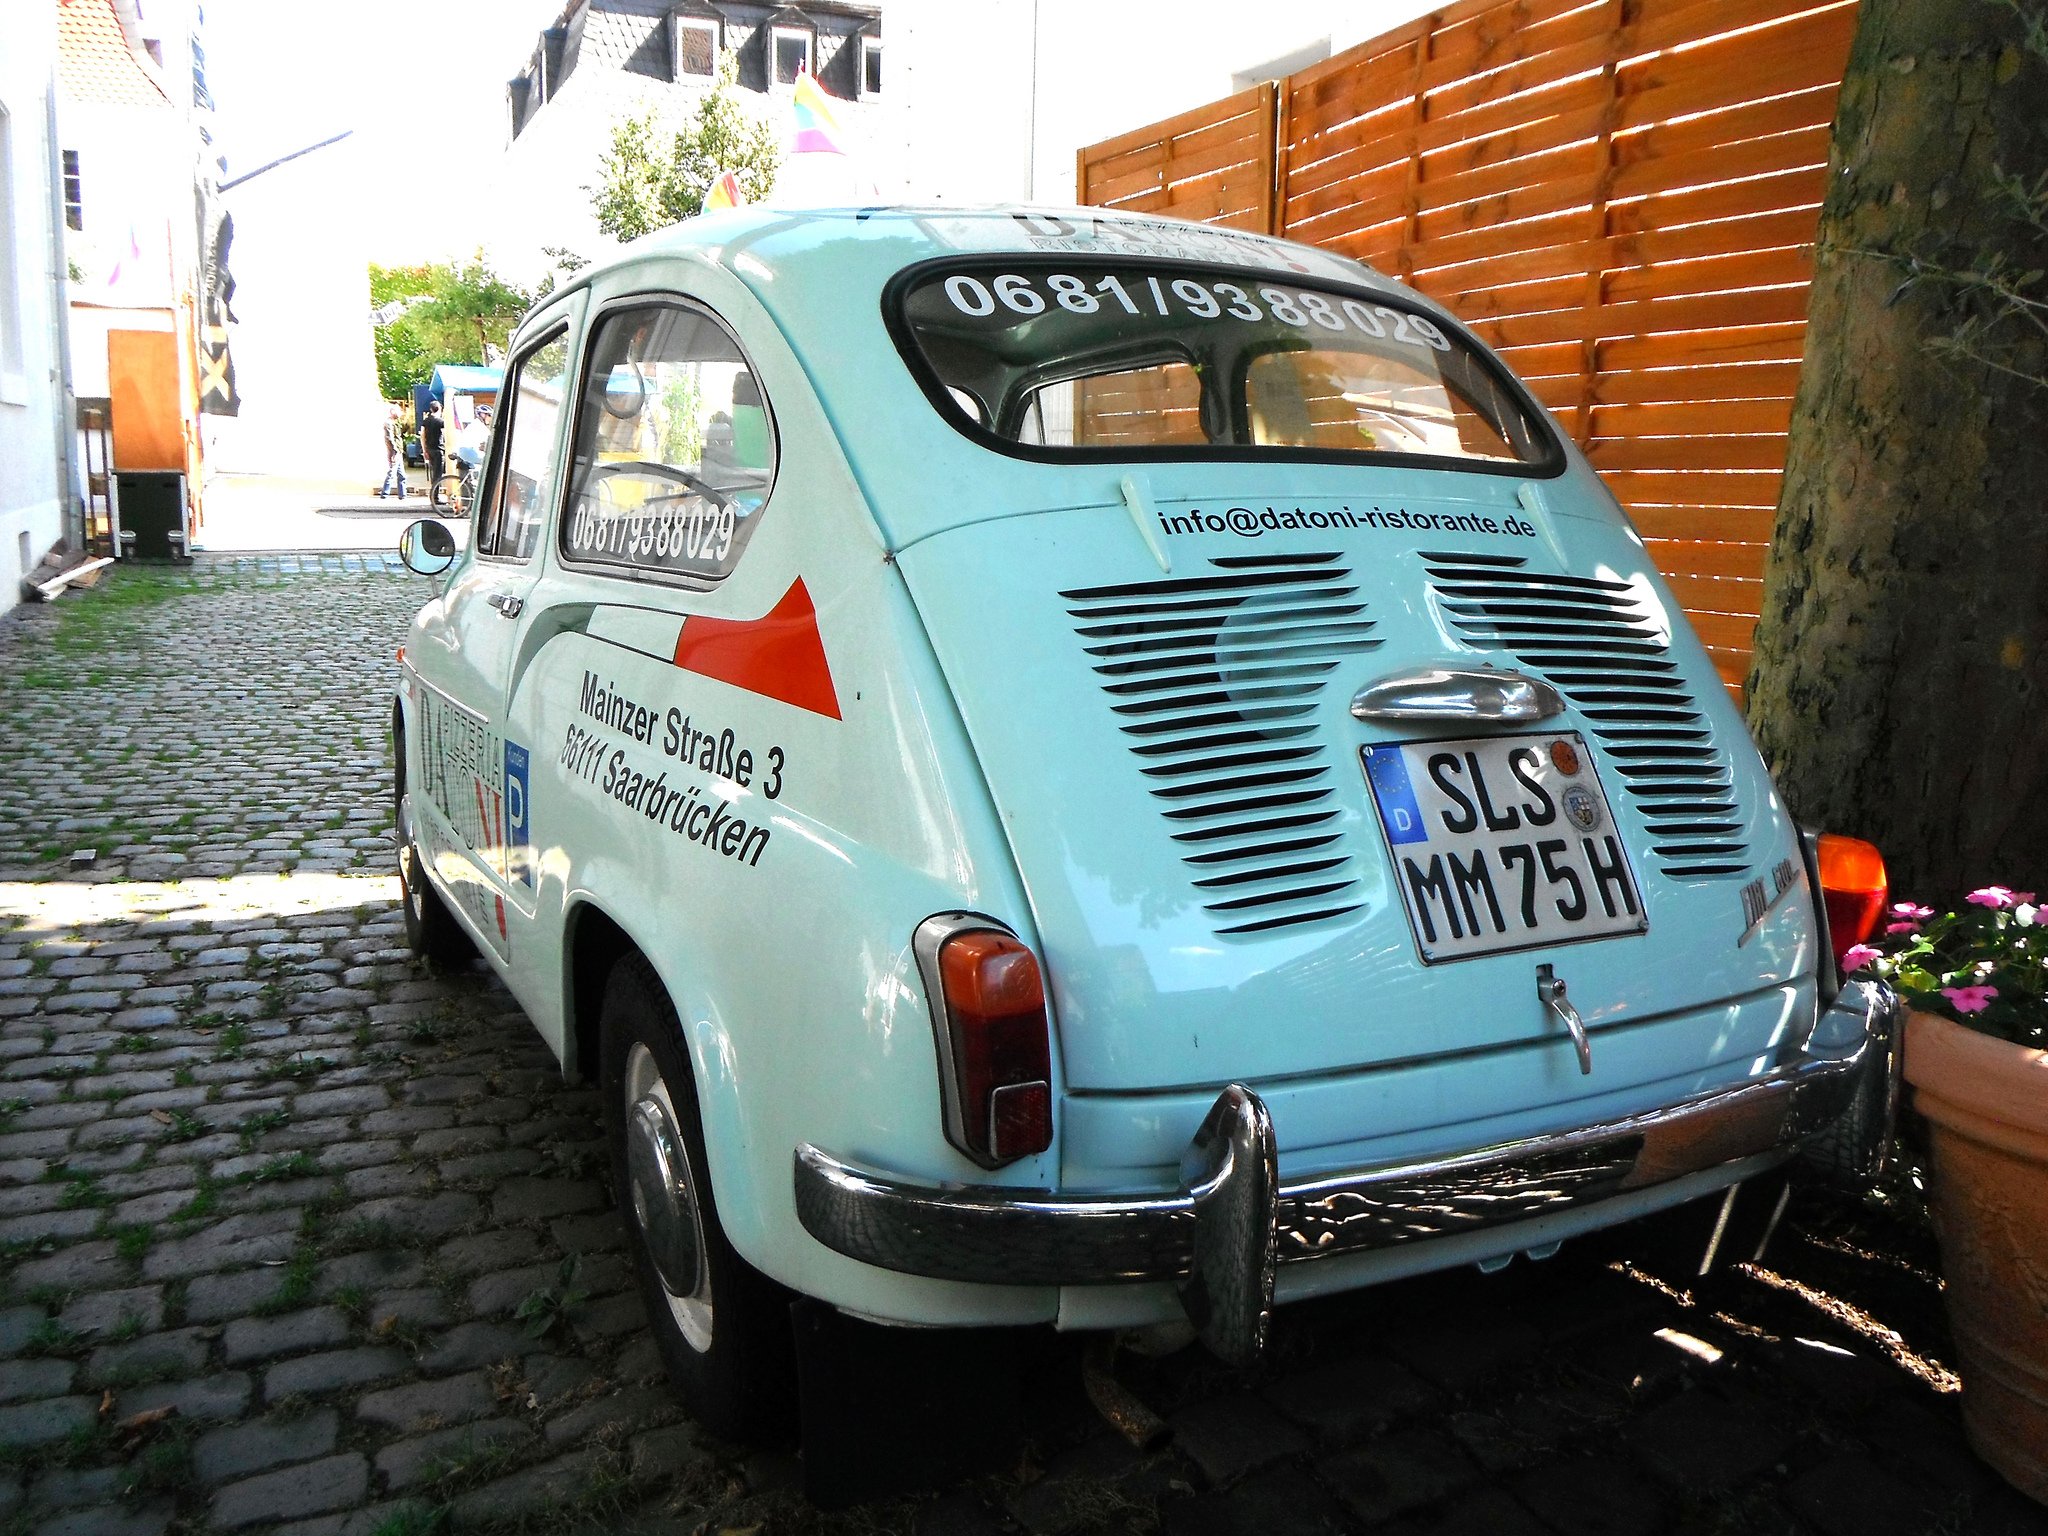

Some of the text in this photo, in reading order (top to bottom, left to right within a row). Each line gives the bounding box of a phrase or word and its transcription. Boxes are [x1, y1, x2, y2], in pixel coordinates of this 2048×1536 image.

[944, 273, 1452, 353] 0681/9388029
[572, 503, 735, 561] 0681/9388029
[1157, 505, 1537, 538] info@datoni-ristorante.de
[444, 702, 503, 792] PIZZERIA
[579, 669, 786, 801] Mainzer Straße 3
[508, 773, 523, 855] P
[561, 723, 771, 867] 66111 Saarbrücken
[1393, 808, 1411, 832] D
[1427, 748, 1557, 834] SLS
[1403, 849, 1506, 943] MM
